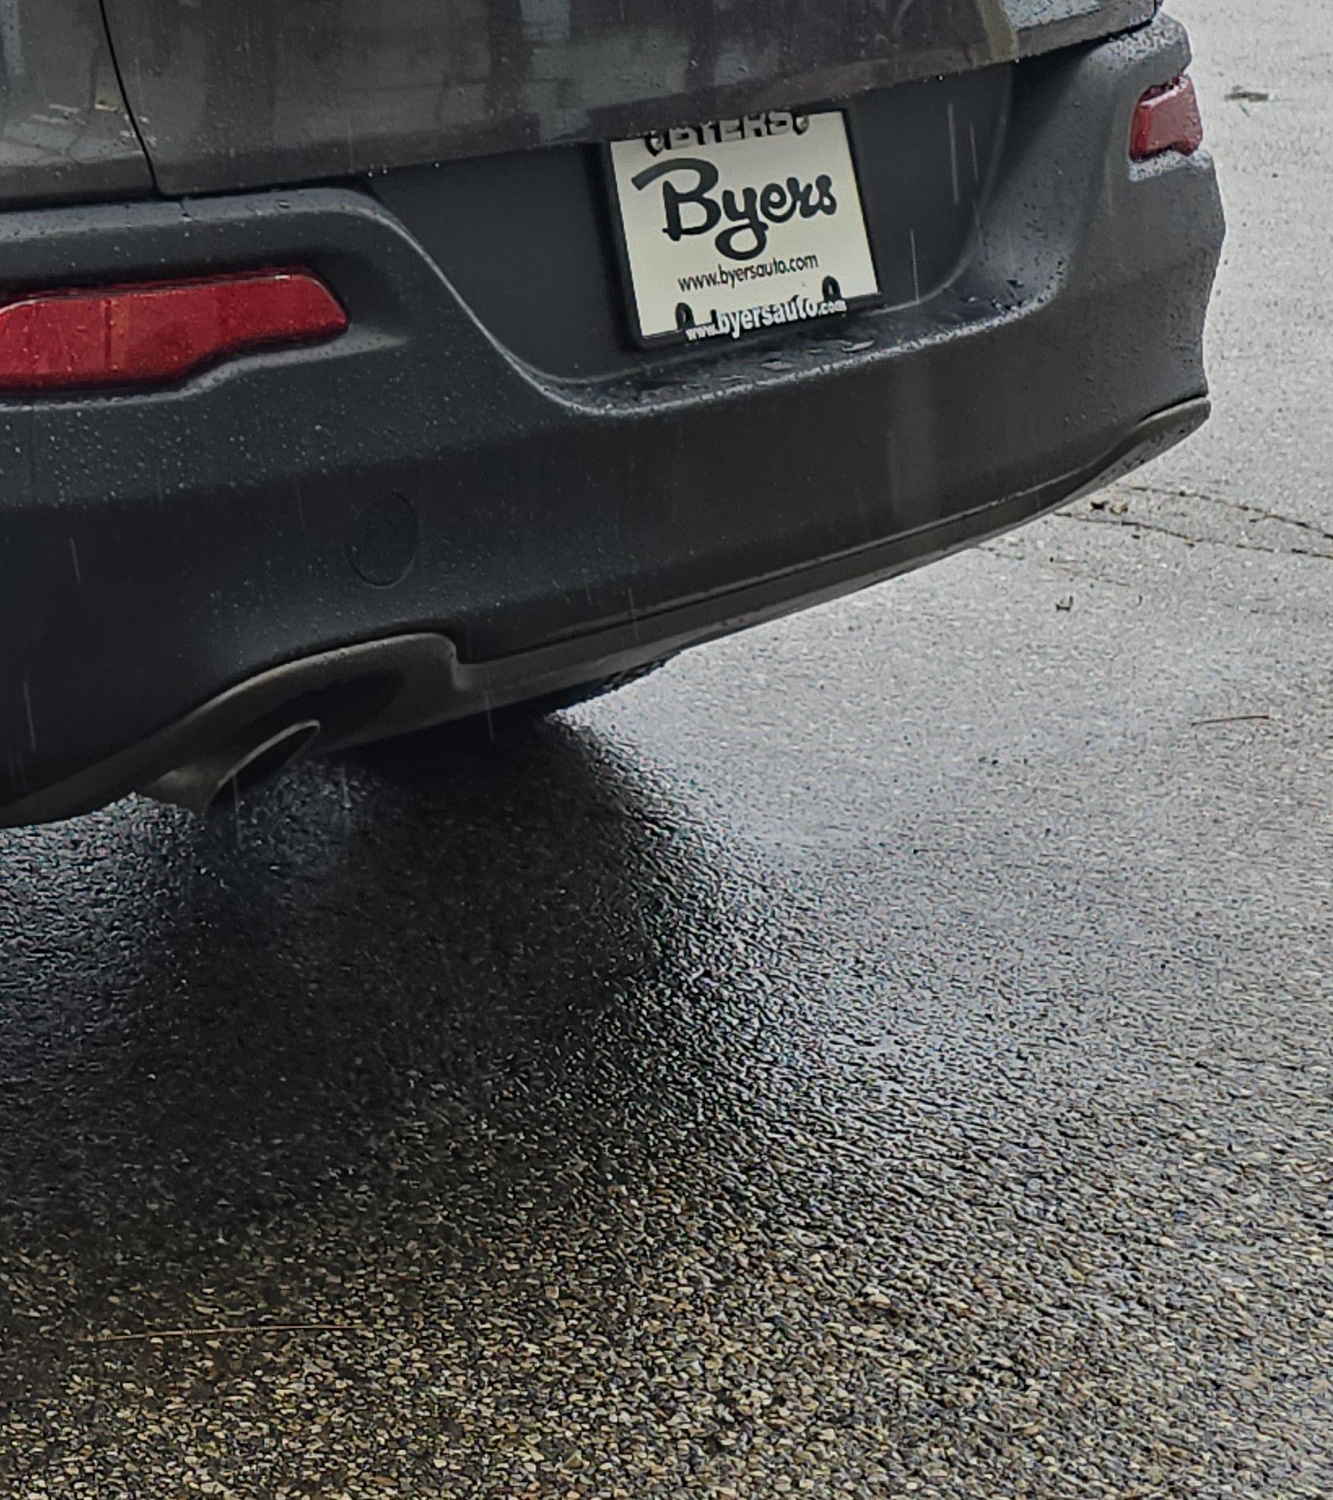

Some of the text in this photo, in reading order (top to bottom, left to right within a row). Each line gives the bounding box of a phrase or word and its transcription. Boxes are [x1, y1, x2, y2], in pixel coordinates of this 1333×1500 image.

[631, 157, 837, 261] Byers
[678, 254, 819, 292] www.byersauto.com
[685, 294, 848, 341] www.byersauto.com
